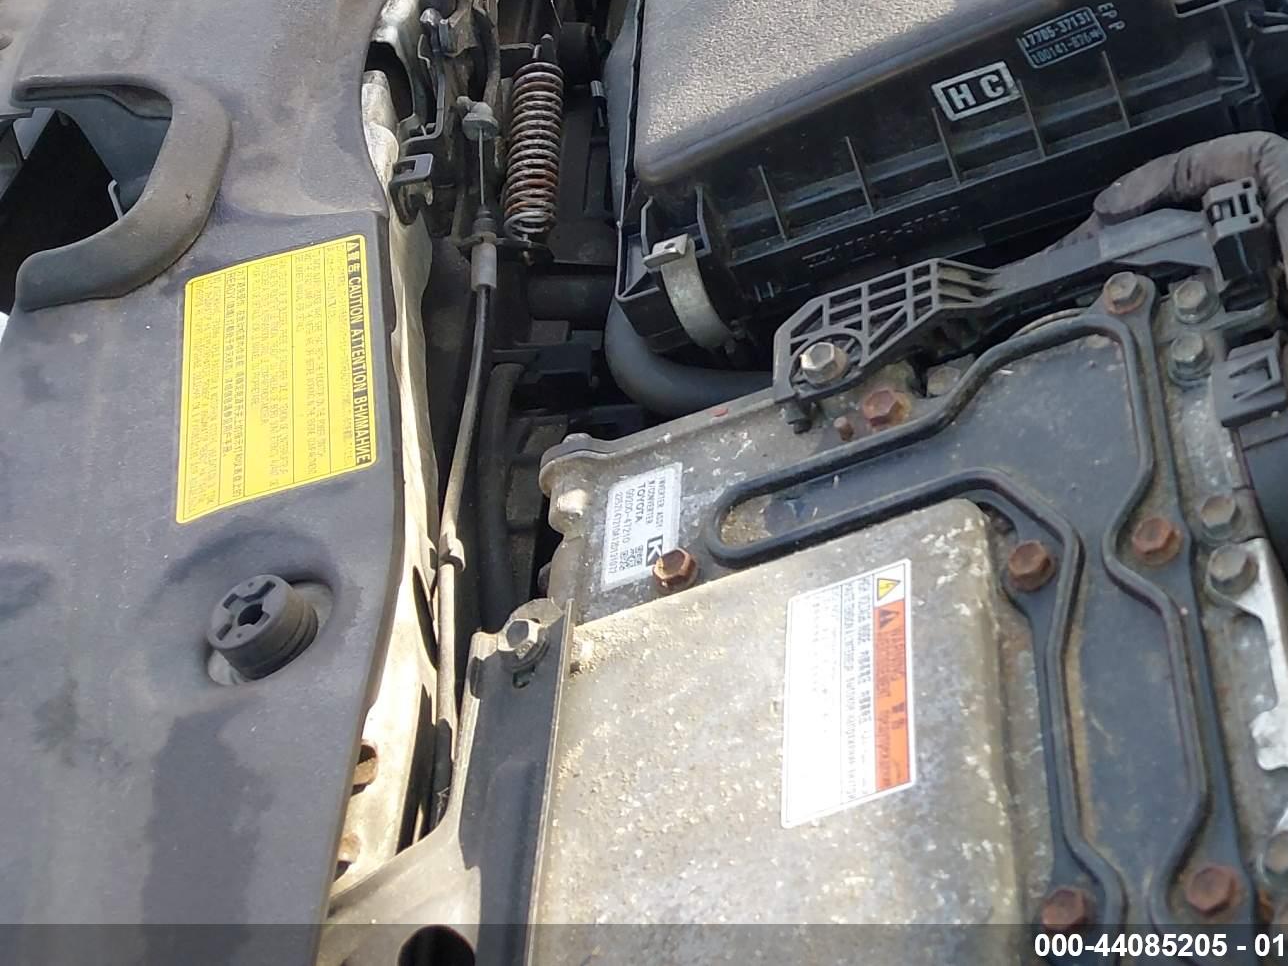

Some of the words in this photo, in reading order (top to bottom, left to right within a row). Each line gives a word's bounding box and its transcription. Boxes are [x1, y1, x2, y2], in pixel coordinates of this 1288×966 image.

[348, 276, 364, 324] CAUTION
[351, 329, 367, 392] ATTENTION
[354, 395, 372, 464] ВНИМАНИЕ
[635, 482, 646, 522] TOYOTA
